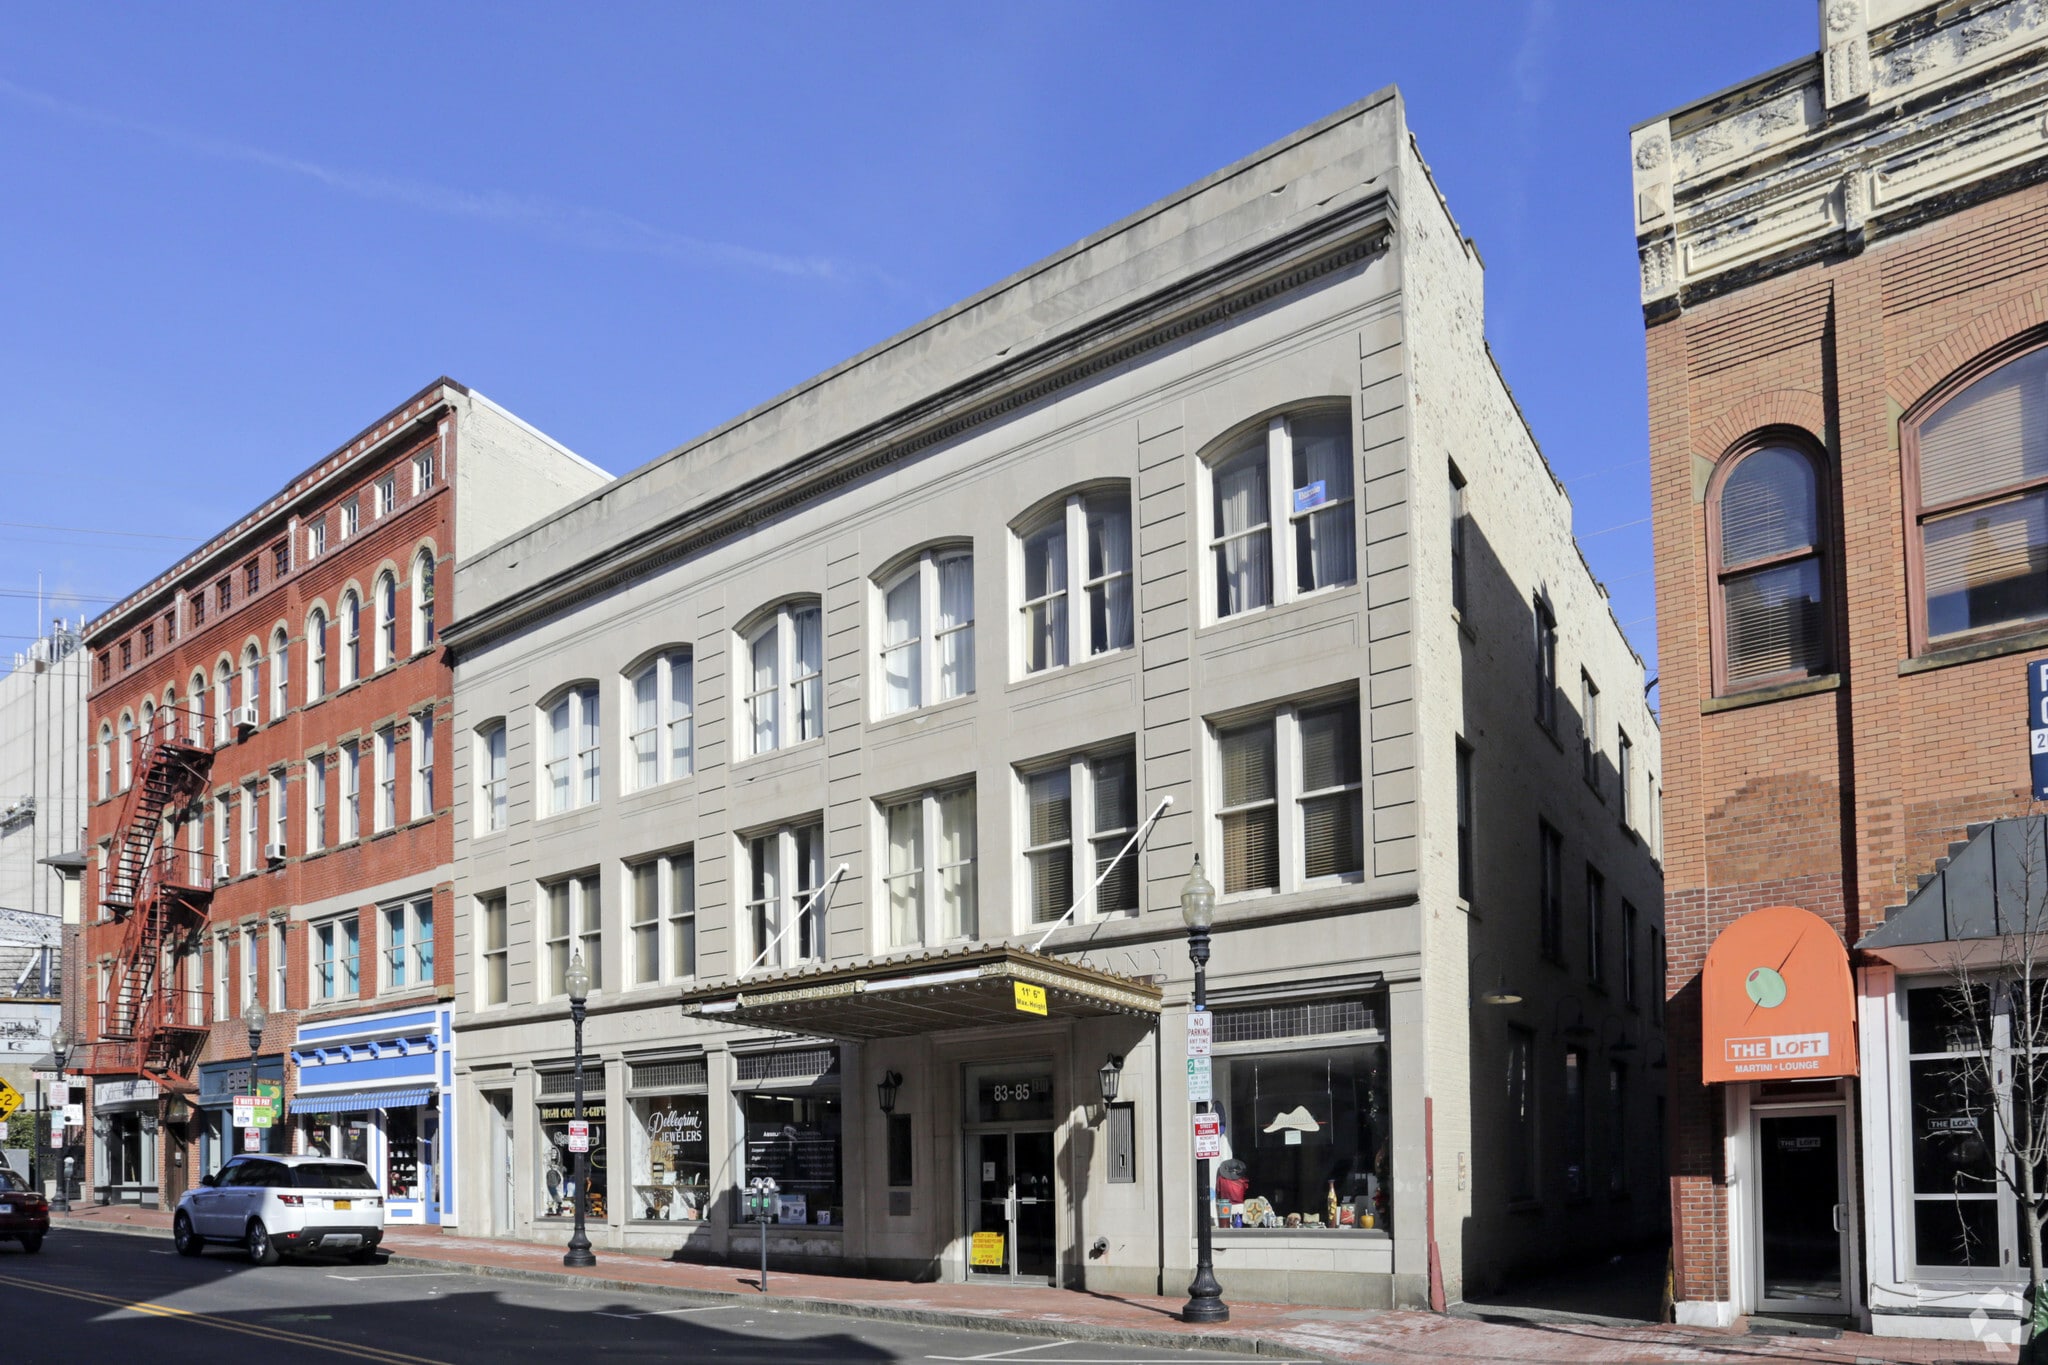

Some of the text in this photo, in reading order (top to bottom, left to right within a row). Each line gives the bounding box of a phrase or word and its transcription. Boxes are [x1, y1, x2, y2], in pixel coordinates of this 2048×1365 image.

[1193, 1018, 1204, 1027] NO
[1188, 1028, 1210, 1037] PARKING
[1731, 1040, 1821, 1058] THE LOFT
[1188, 1061, 1194, 1073] 2
[1735, 1060, 1819, 1073] MARTINI LOUNGE
[994, 1083, 1030, 1101] 83-85
[647, 1110, 702, 1140] Pellegrini
[1932, 1120, 1949, 1128] THE
[659, 1130, 702, 1142] JEWELERS
